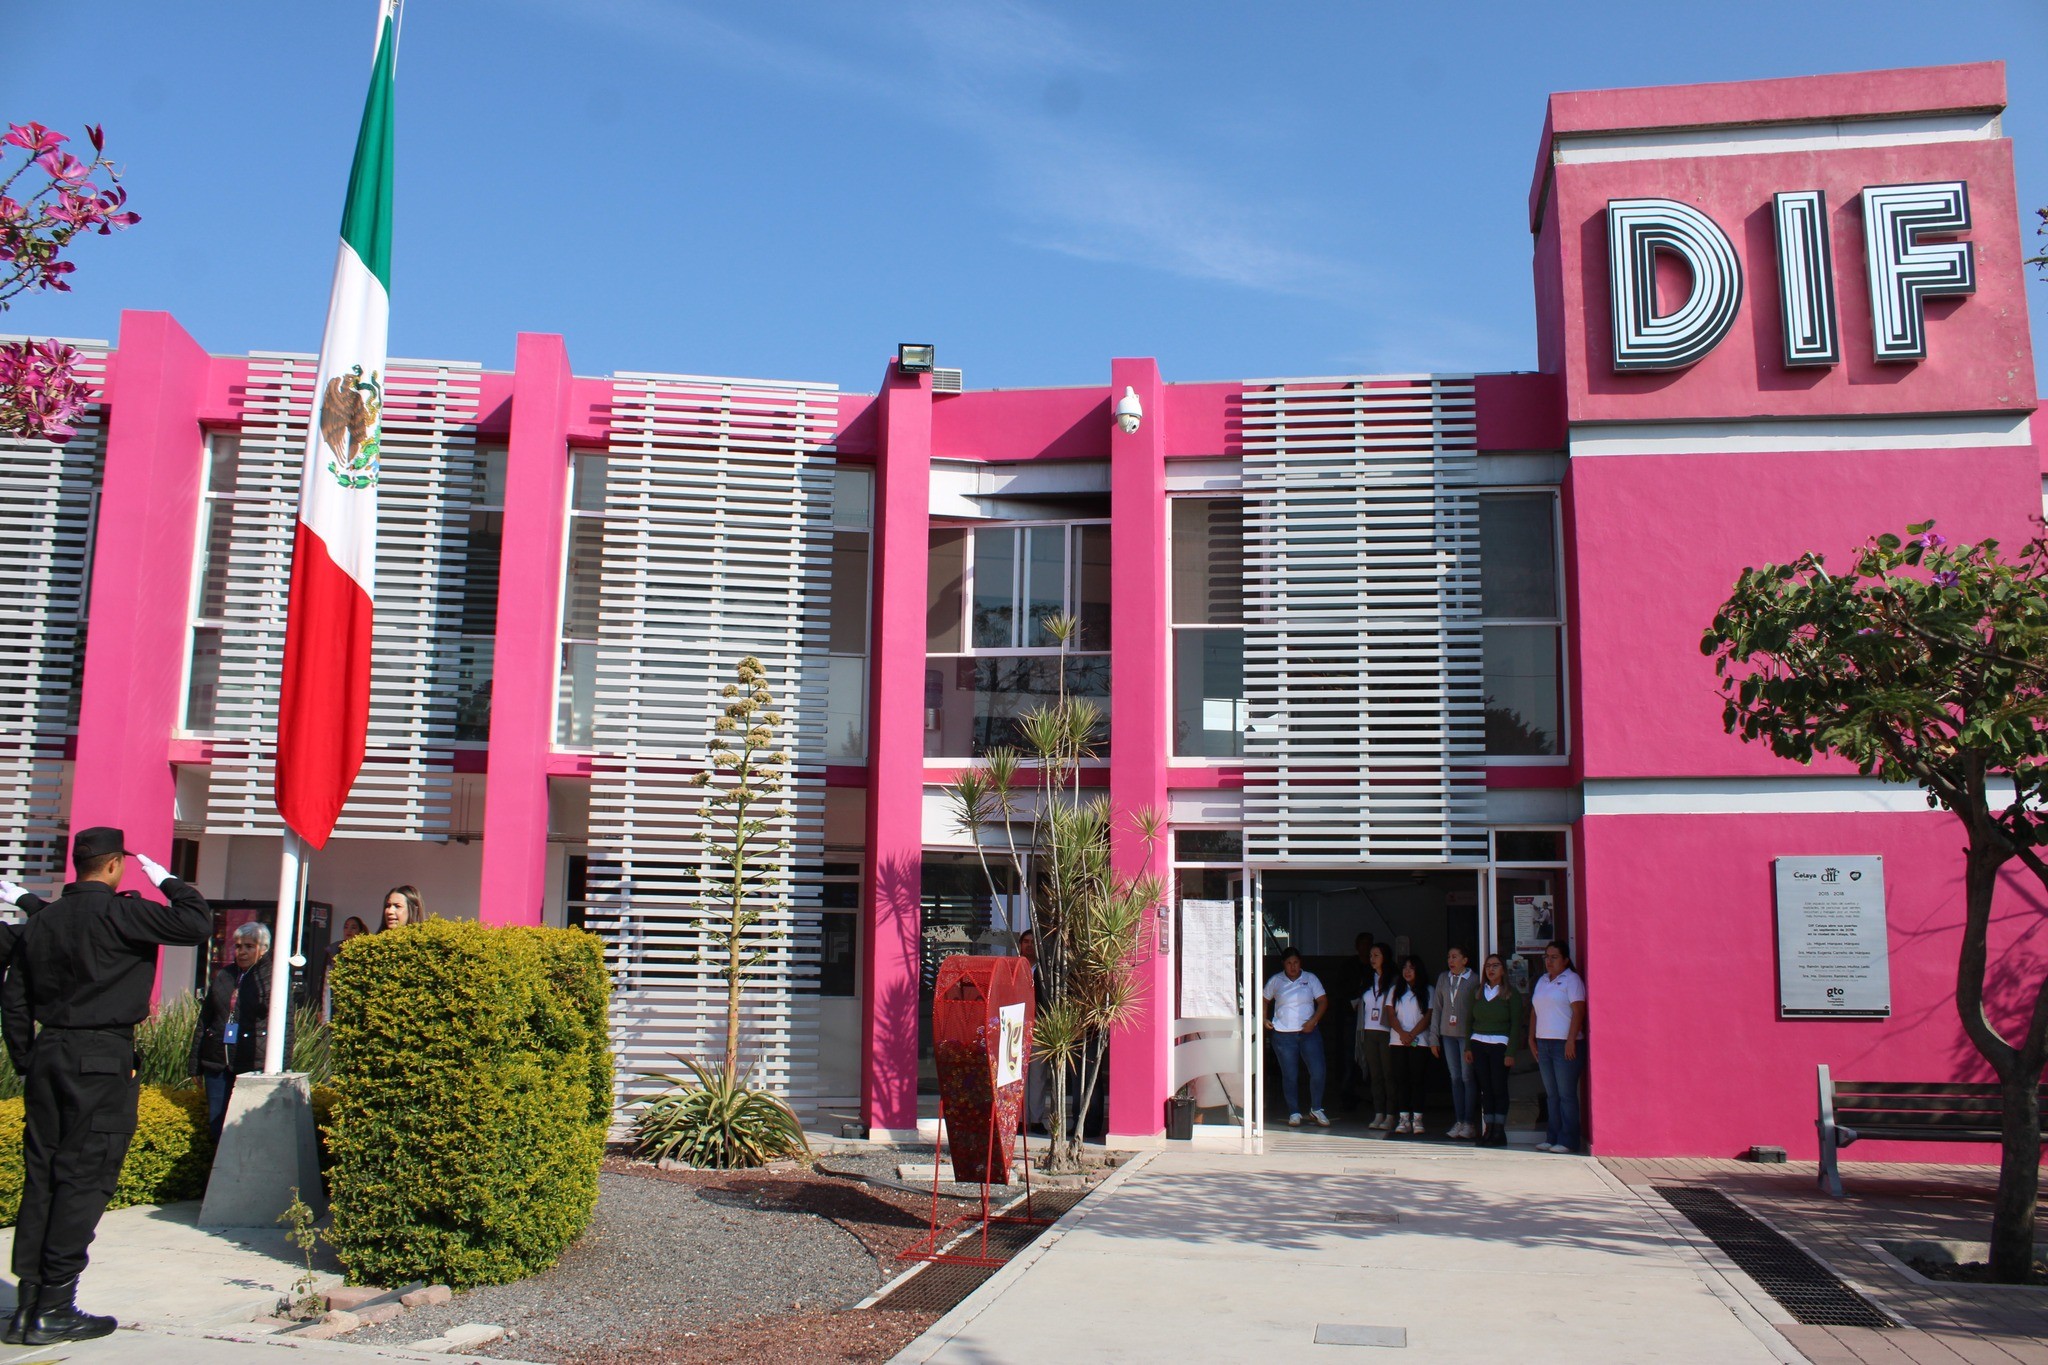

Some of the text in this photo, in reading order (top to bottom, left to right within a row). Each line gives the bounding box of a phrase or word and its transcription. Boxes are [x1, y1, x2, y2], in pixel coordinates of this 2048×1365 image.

[1607, 180, 1976, 373] DIF
[1794, 871, 1817, 879] Celaya
[1826, 987, 1844, 998] gto
